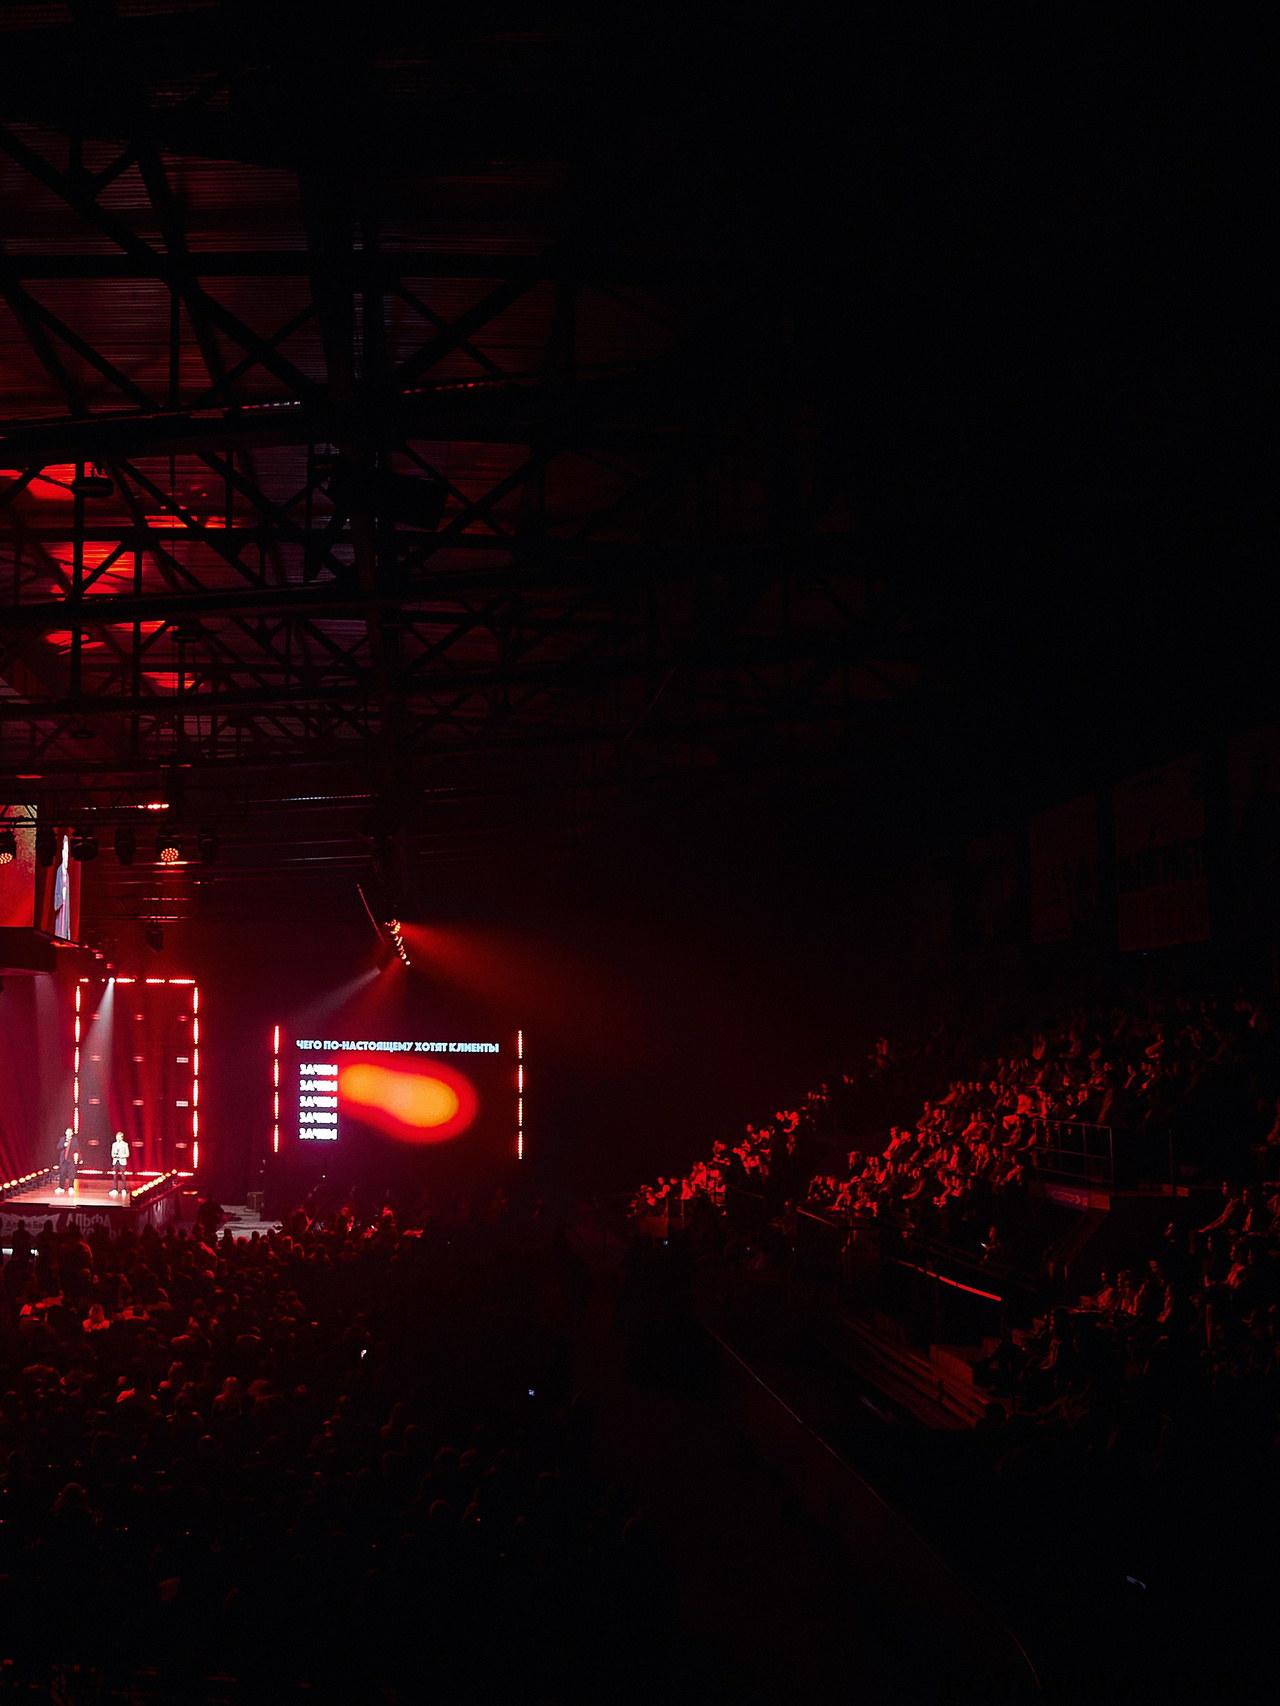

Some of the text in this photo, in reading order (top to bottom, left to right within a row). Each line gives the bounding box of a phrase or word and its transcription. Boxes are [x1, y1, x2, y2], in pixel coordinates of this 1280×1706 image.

[296, 1040, 499, 1052] ЧЕГО ПО-НАСТОЯЩЕМУ ХОТЯТ КЛИЕНТЫ
